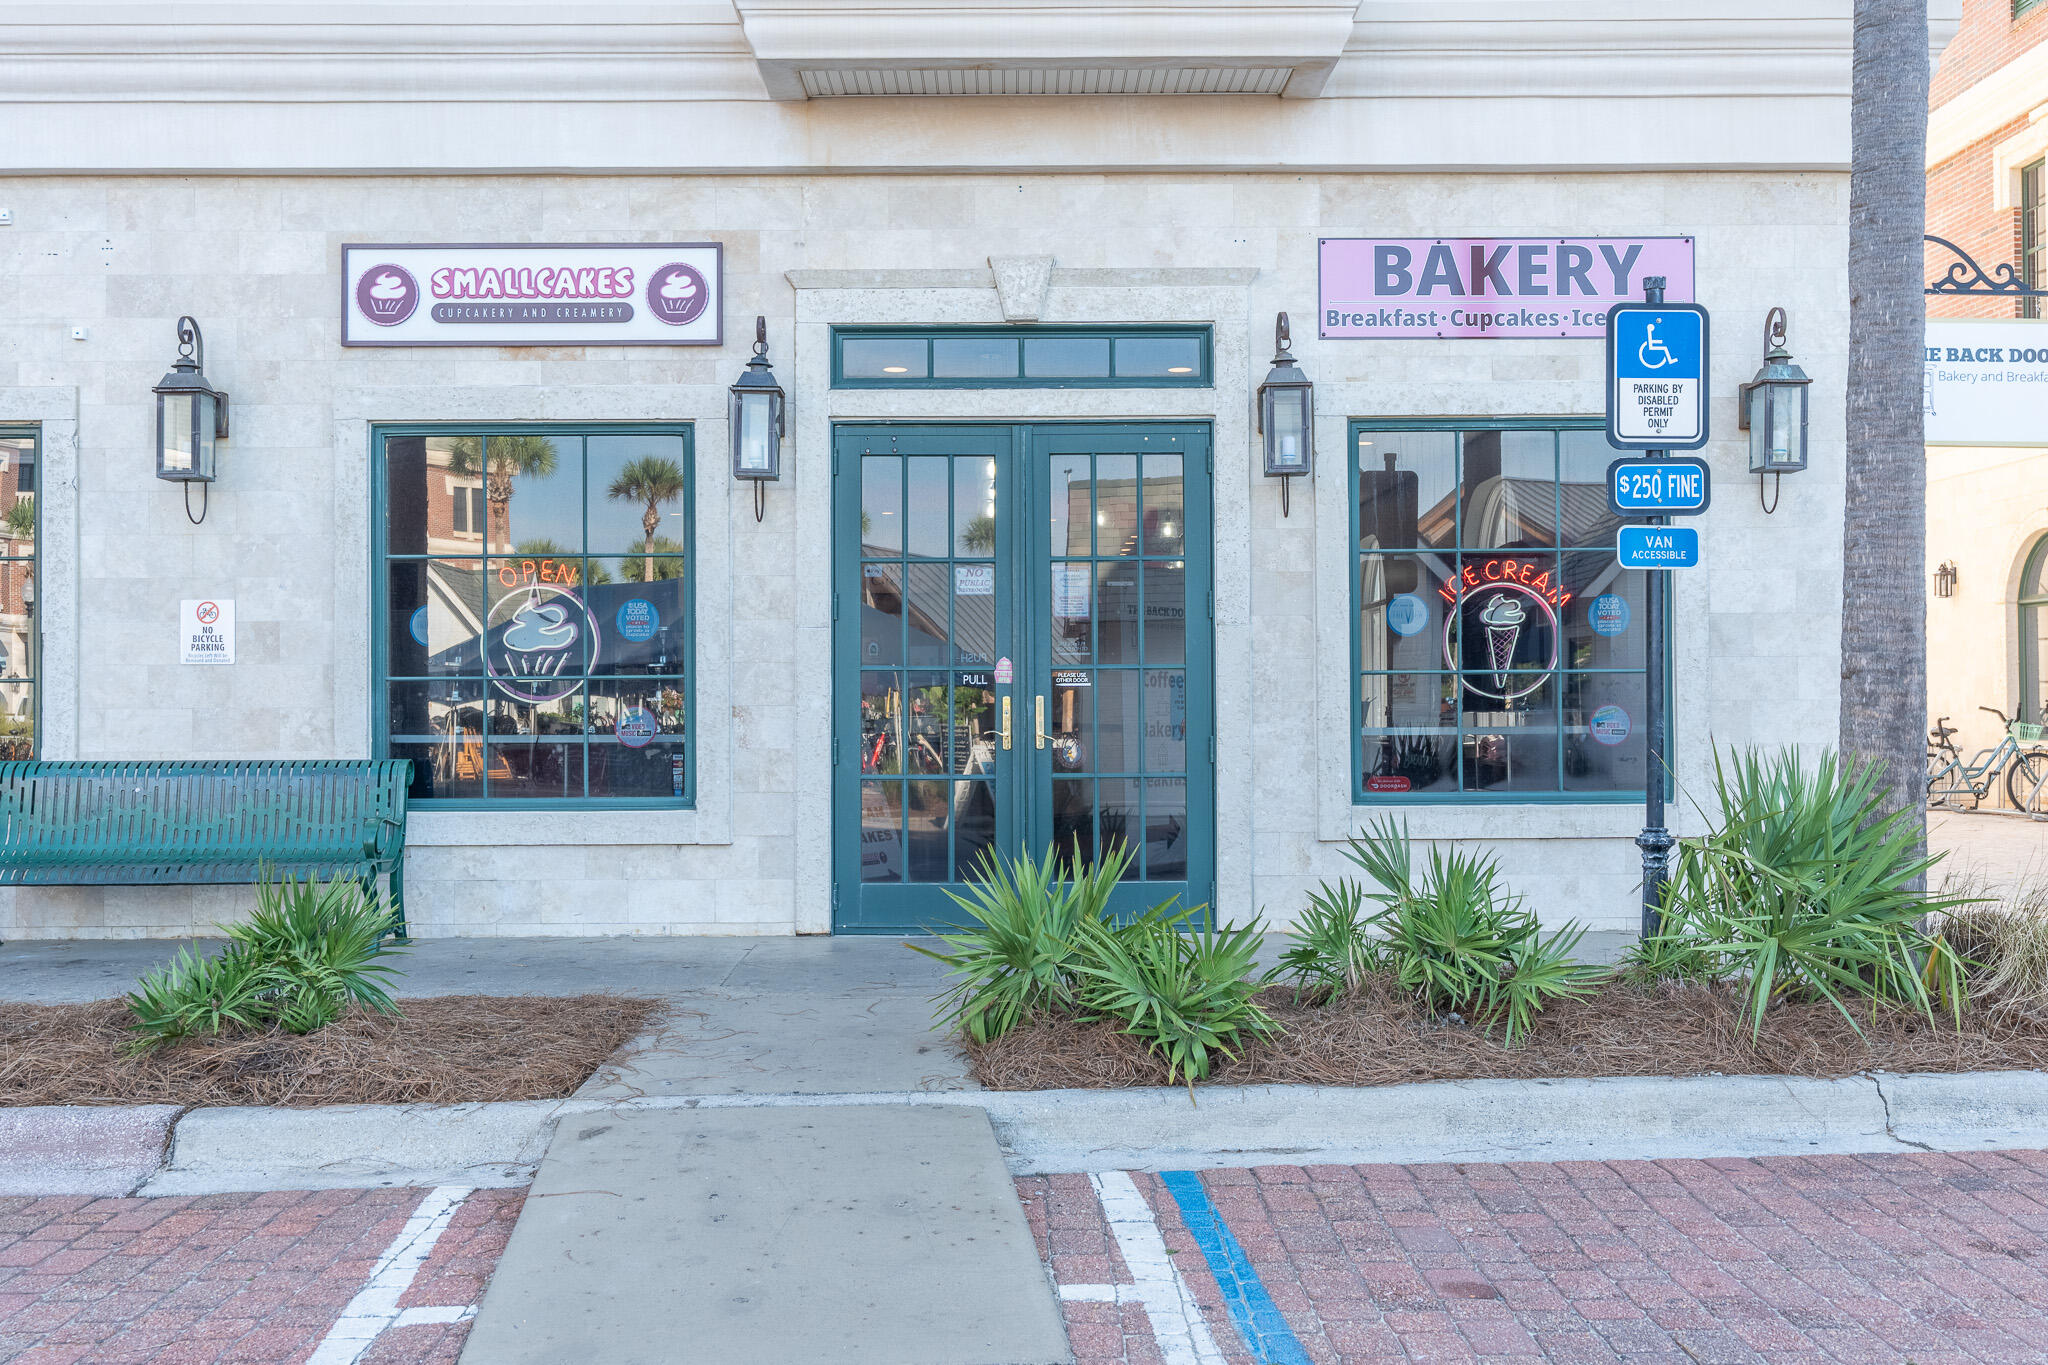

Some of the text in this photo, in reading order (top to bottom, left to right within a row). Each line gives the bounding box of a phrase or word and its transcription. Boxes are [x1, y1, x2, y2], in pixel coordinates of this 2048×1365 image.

[1373, 244, 1643, 297] BAKERY
[431, 267, 635, 299] SMALLCAKES
[439, 307, 623, 318] CUPCAKERY AND CREAMERY
[1946, 347, 2004, 363] BACK
[1938, 370, 1978, 384] Bakery
[1981, 371, 2003, 382] and
[1633, 384, 1684, 394] PARKING BY
[1638, 395, 1679, 405] DISABLED
[1643, 406, 1674, 417] PERMIT
[1647, 418, 1669, 428] ONLY
[1619, 474, 1700, 499] $250 FINE
[1645, 535, 1673, 548] VAN
[1631, 550, 1687, 560] ACCESSIBLE
[499, 559, 577, 588] OPEN
[966, 568, 984, 578] NO
[1438, 559, 1572, 608] ICE CREAM
[962, 674, 988, 685] PULL
